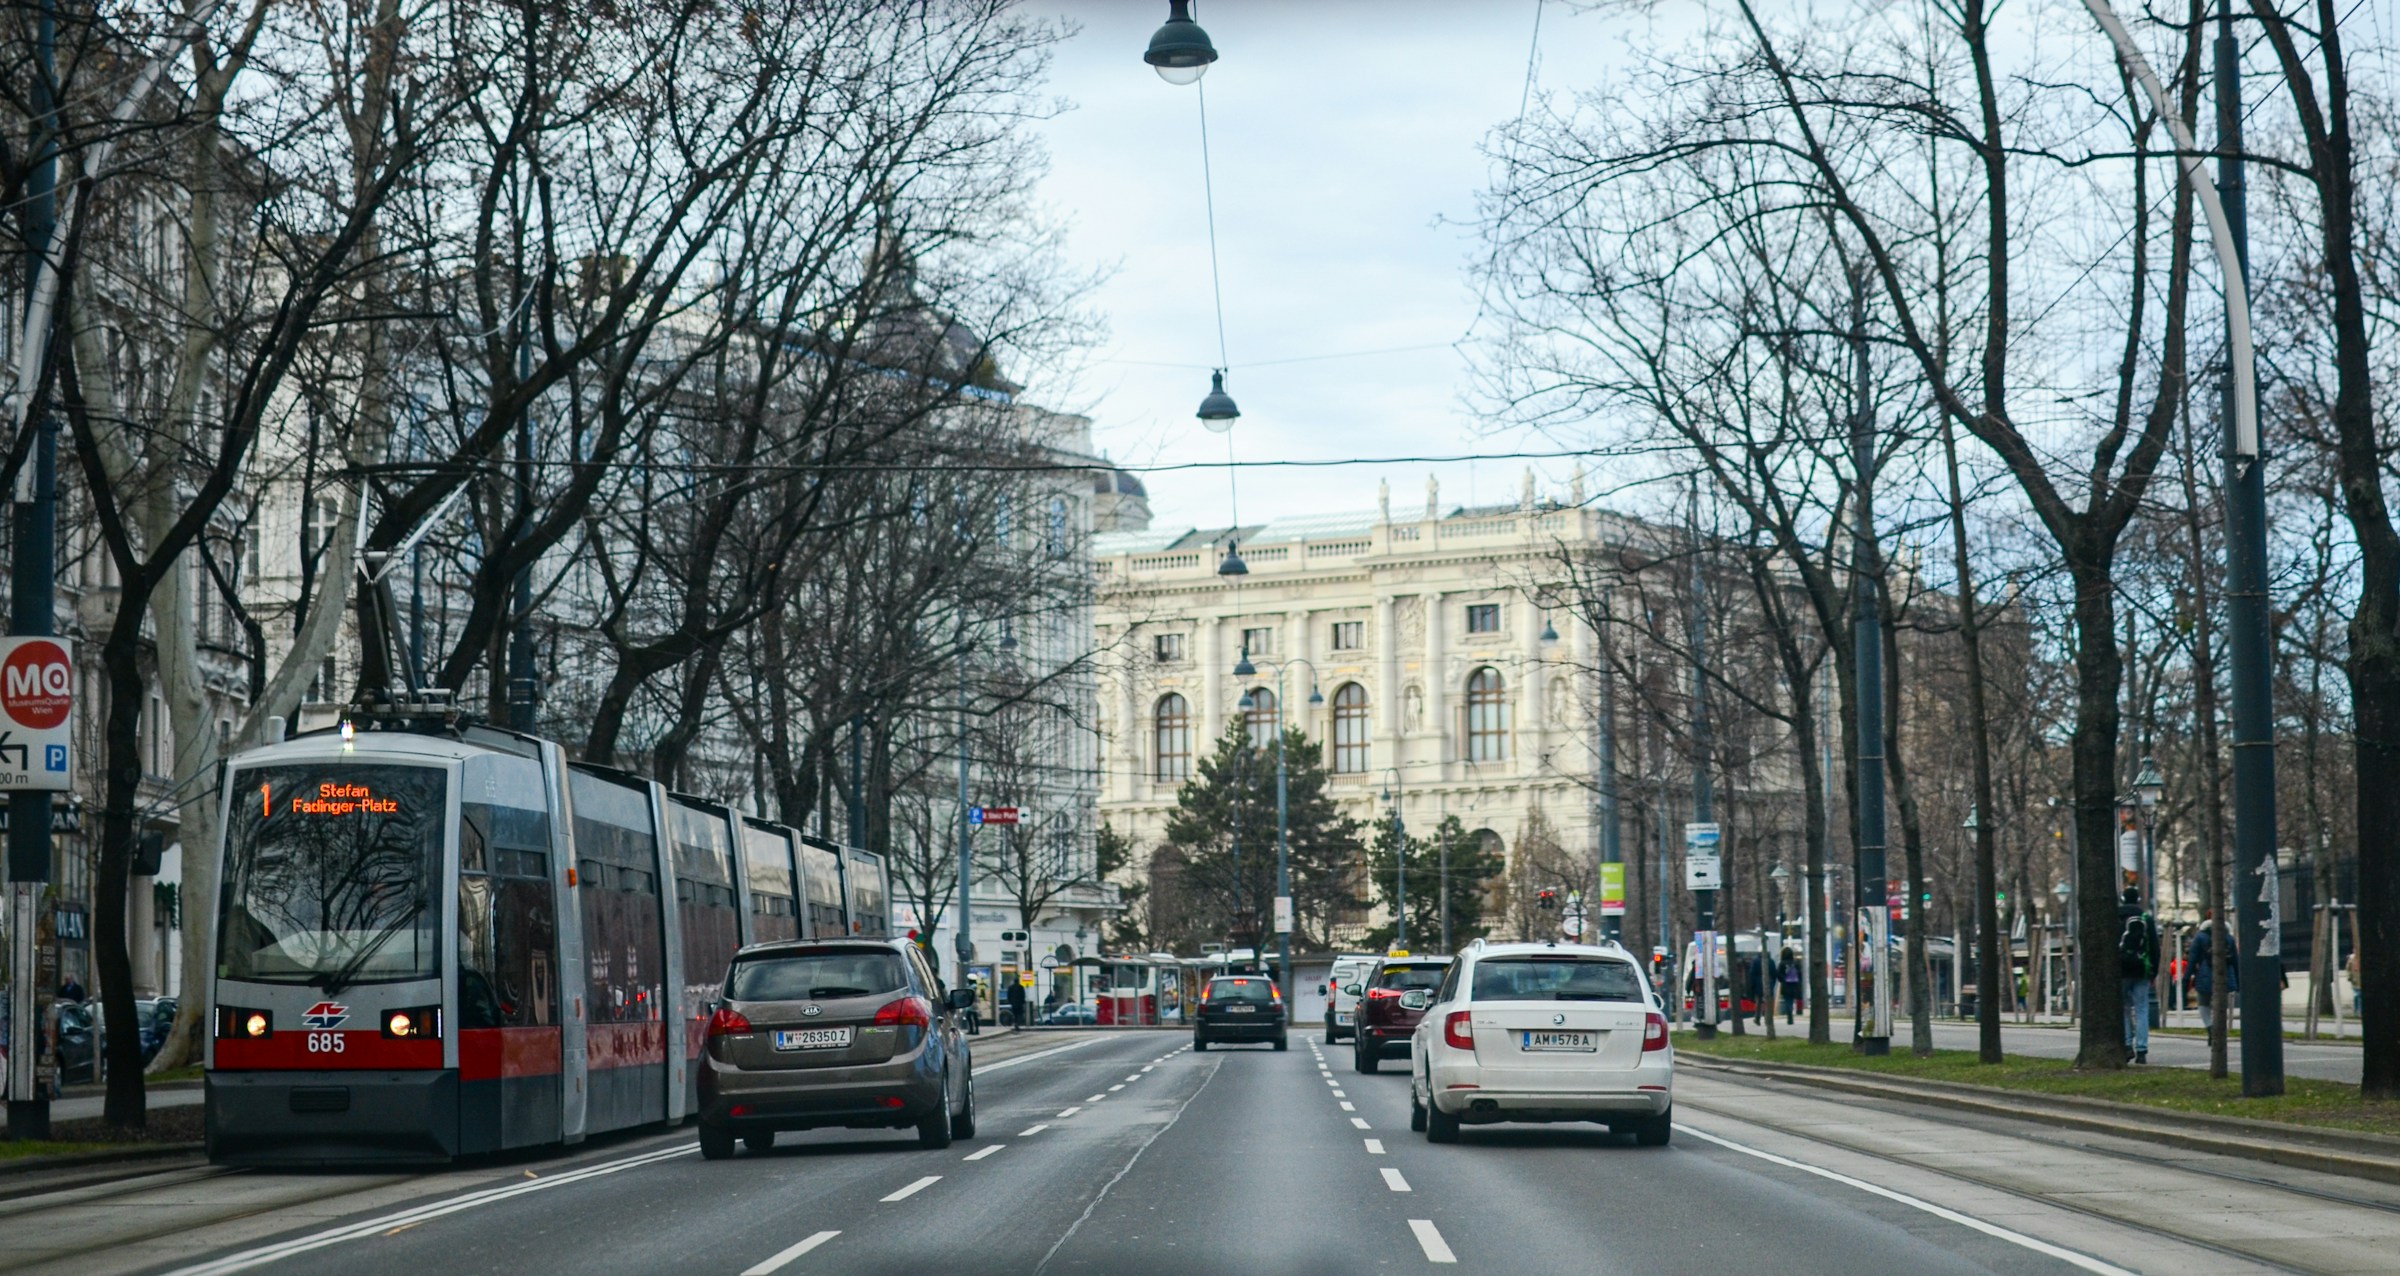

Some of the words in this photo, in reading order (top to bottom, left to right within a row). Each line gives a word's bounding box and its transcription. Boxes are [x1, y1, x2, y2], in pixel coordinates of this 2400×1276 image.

[7, 662, 70, 698] MQ
[32, 706, 53, 715] Wien
[15, 775, 28, 784] m
[320, 783, 368, 798] Stefan
[261, 783, 270, 817] 1
[292, 798, 397, 815] Fadinger-Platz
[803, 1006, 821, 1015] KIA
[308, 1033, 345, 1053] 685
[785, 1033, 794, 1043] W
[1534, 1034, 1550, 1046] AM
[1558, 1033, 1580, 1046] 578
[1581, 1034, 1590, 1046] A
